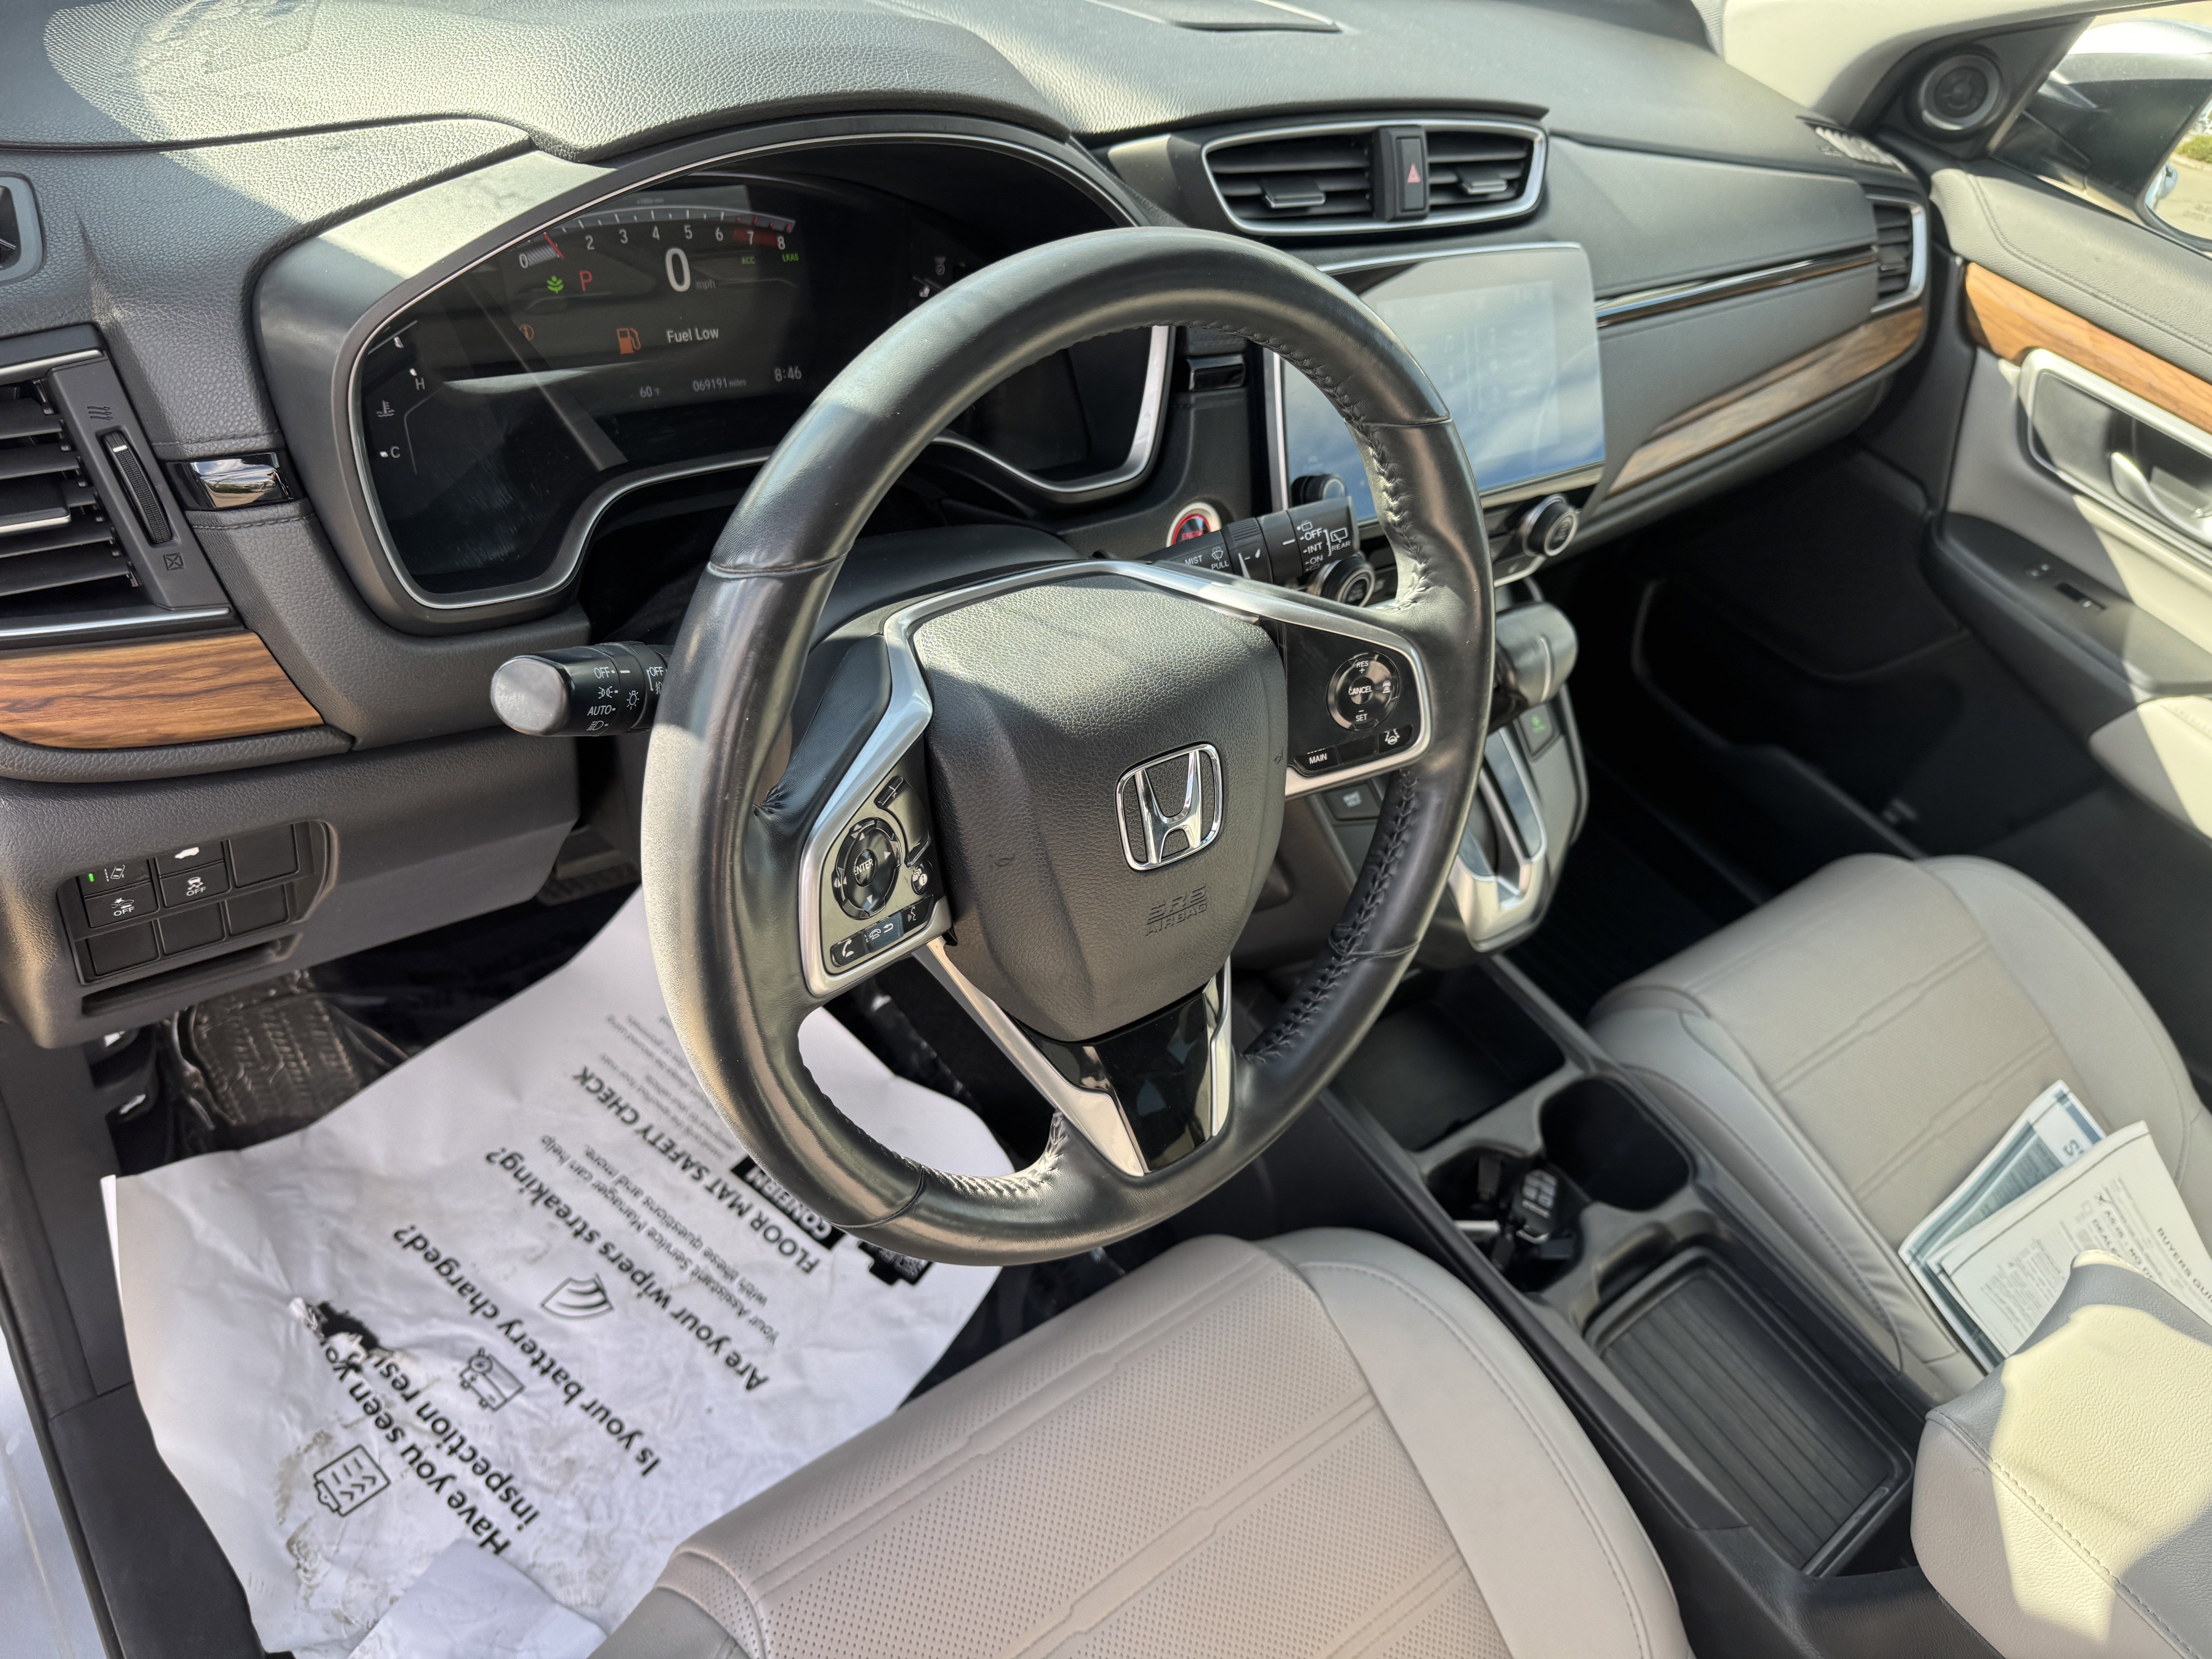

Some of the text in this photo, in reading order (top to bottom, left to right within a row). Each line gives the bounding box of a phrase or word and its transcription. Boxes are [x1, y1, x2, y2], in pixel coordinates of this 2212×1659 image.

[585, 235, 595, 250] 2
[620, 228, 628, 244] 3
[652, 225, 659, 240] 4
[684, 224, 692, 239] 5
[715, 227, 723, 241] 6
[747, 230, 754, 245] 7
[777, 235, 785, 250] 8
[665, 247, 716, 292] 0 mph
[579, 271, 592, 291] P
[666, 327, 719, 343] Fuel Low
[774, 366, 802, 382] 8:46
[415, 377, 425, 390] H
[693, 377, 727, 392] 069191
[390, 446, 400, 459] C
[1304, 527, 1323, 541] OFF
[1307, 542, 1323, 554] INT
[1331, 540, 1351, 552] REAR
[1185, 555, 1203, 565] MIST
[1211, 561, 1230, 570] PULL
[1309, 554, 1323, 564] ON
[594, 666, 610, 679] OFF
[649, 666, 664, 678] OFF
[1348, 686, 1373, 696] CANCEL
[587, 705, 612, 716] AUTO
[1355, 713, 1368, 722] SET
[1309, 752, 1328, 764] MAIN
[854, 858, 874, 876] ENTER
[186, 886, 206, 896] OFF
[113, 906, 135, 916] OFF
[574, 1068, 639, 1125] CHECK
[636, 1125, 709, 1181] SAFETY
[705, 1179, 752, 1217] MAT
[744, 1165, 833, 1242] CONFIRM
[586, 1147, 766, 1305] with these questions and more.
[541, 1136, 777, 1344] Your Assistant Service Manager can help
[750, 1212, 819, 1273] FLOOR
[2157, 1227, 2191, 1277] BUYERS
[486, 1149, 768, 1391] Are your wipers streaking?
[394, 1226, 659, 1476] Is your battery charged?
[349, 1382, 405, 1443] seen
[400, 1444, 455, 1493] you
[417, 1403, 538, 1530] inspection
[448, 1491, 510, 1554] Have
